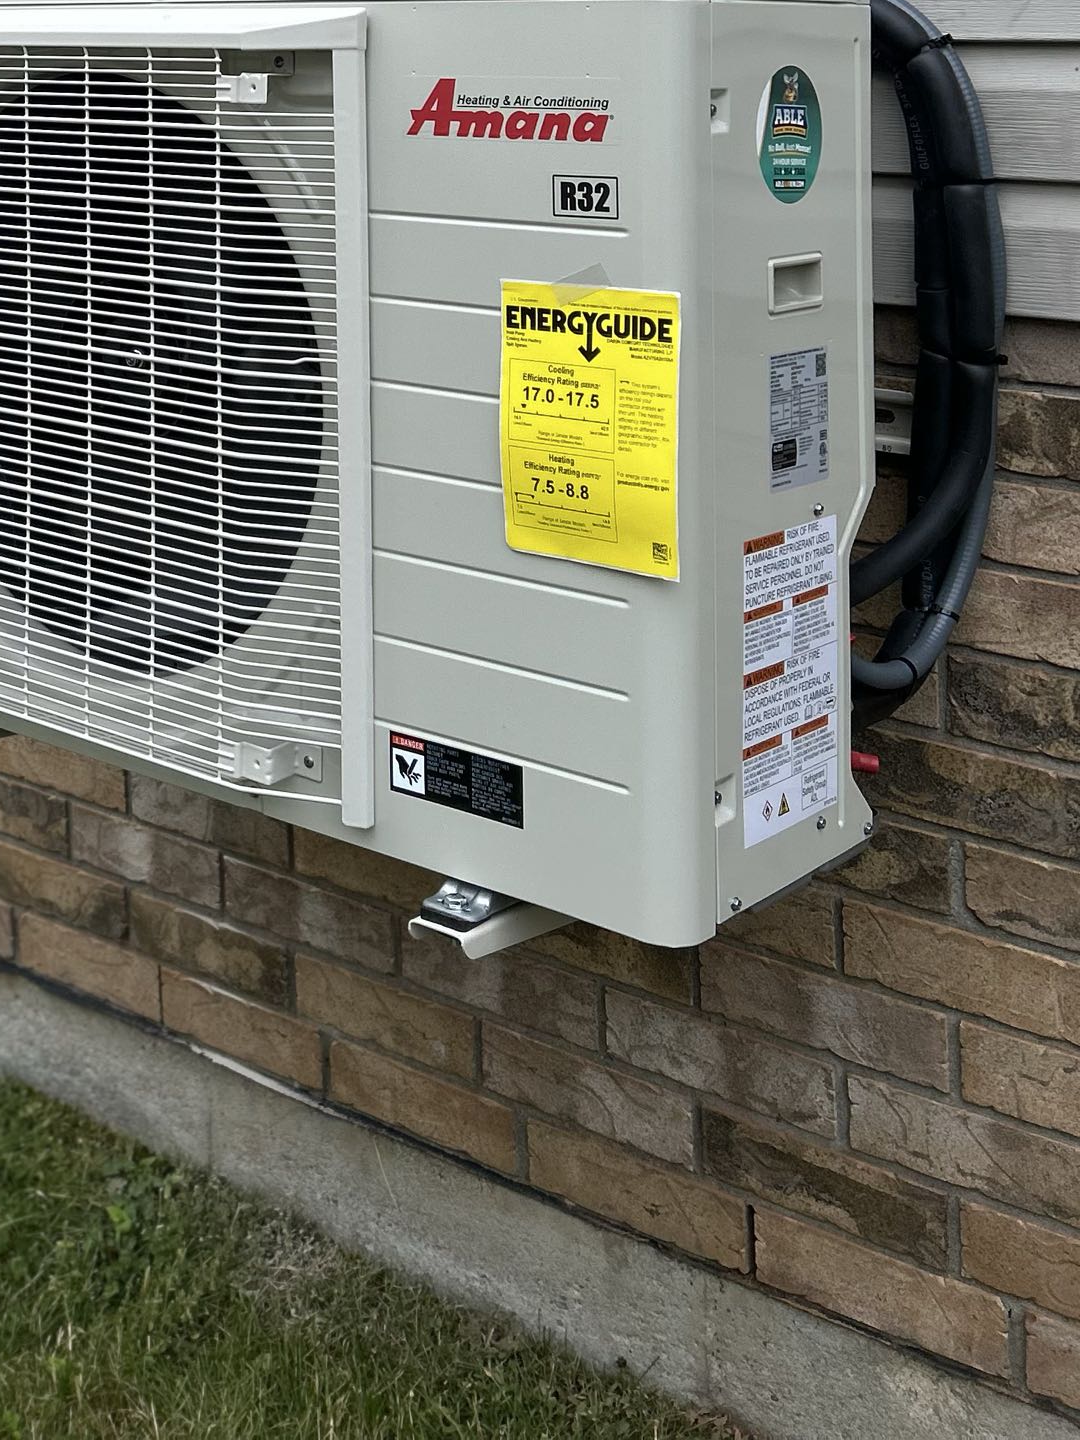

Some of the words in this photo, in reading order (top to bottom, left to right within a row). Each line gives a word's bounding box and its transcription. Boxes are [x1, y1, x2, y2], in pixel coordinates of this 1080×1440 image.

[407, 78, 609, 142] Amana
[457, 94, 499, 109] Heating
[503, 95, 511, 106] &
[513, 95, 531, 107] Air
[534, 96, 609, 111] Conditioning
[774, 108, 805, 126] ABLE
[560, 181, 610, 213] R32
[506, 305, 673, 344] ENERGYGUIDE
[522, 373, 556, 385] Efficiency
[557, 377, 579, 388] Rating
[548, 365, 575, 377] Cooling
[523, 385, 555, 403] 17.0
[566, 391, 599, 409] 17.5
[524, 461, 557, 474] Efficiency
[558, 466, 580, 478] Rating
[548, 453, 575, 466] Heating
[531, 477, 555, 494] 7.5
[566, 483, 589, 500] 8.8
[753, 532, 784, 552] WARNING
[786, 529, 800, 540] RISK
[800, 525, 808, 536] OF
[808, 521, 819, 533] FIRE
[745, 550, 778, 567] FLAMMABLE
[779, 536, 815, 556] REFRIGERANT
[745, 570, 753, 580] TO
[754, 567, 762, 578] BE
[763, 558, 790, 575] REPAIRED
[790, 555, 805, 567] ONLY
[805, 551, 813, 561] BY
[813, 543, 834, 559] TRAINED
[745, 579, 769, 595] SERVICE
[804, 565, 812, 574] DO
[813, 560, 824, 572] NOT
[745, 590, 776, 608] PUNCTURE
[776, 577, 813, 598] REFRIGERANT
[752, 662, 784, 682] WARNING
[786, 658, 800, 669] RISK
[799, 654, 808, 665] OF
[808, 649, 820, 661] FIRE
[745, 683, 769, 701] DISPOSE
[769, 678, 778, 691] OF
[778, 668, 807, 687] PROPERLY
[807, 665, 814, 675] IN
[745, 690, 782, 714] ACCORDANCE
[783, 683, 798, 699] WITH
[798, 677, 822, 693] FEDERAL
[822, 671, 831, 682] OR
[745, 715, 761, 729] LOCAL
[803, 683, 834, 703] FLAMMABLE
[400, 736, 424, 751] DANGER
[744, 718, 783, 742] REFRIGERANT
[802, 784, 814, 797] Safety
[814, 779, 827, 790] Group
[803, 769, 825, 784] Refrigerant
